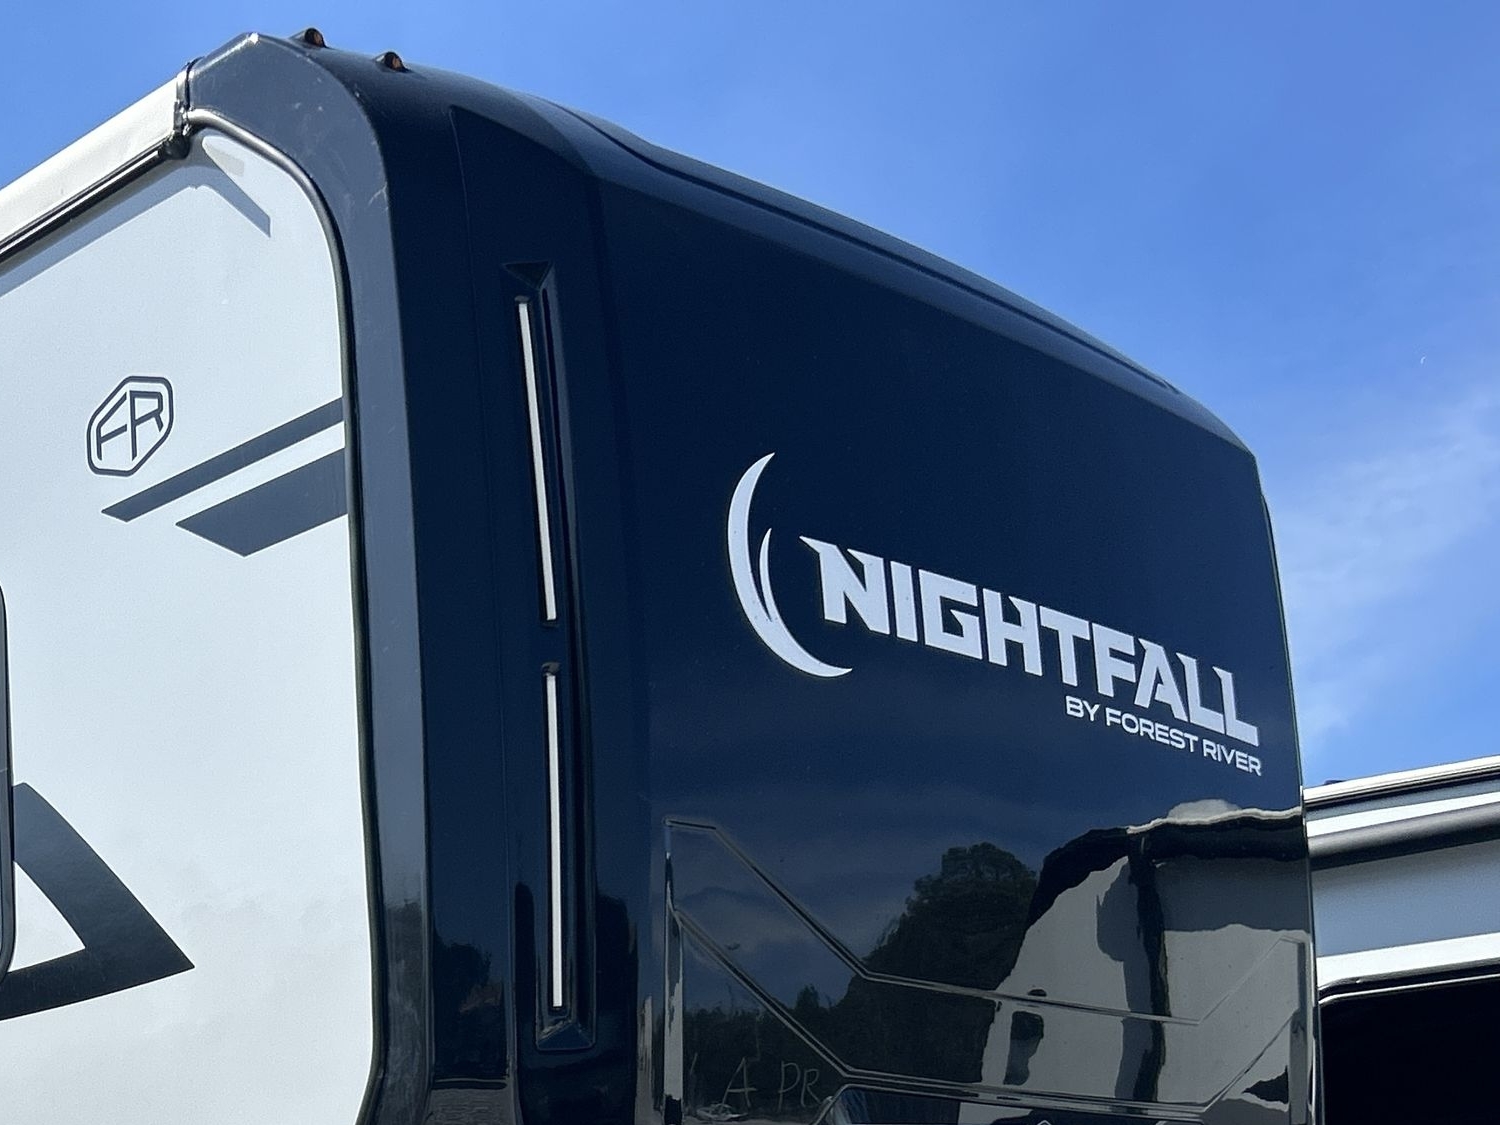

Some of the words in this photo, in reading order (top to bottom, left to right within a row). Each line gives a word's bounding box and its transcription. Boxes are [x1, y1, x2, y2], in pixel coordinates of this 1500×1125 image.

[800, 536, 1259, 746] NIGHTFALL
[1066, 696, 1100, 721] BY
[1106, 707, 1198, 752] FOREST
[1203, 739, 1262, 776] RIVER
